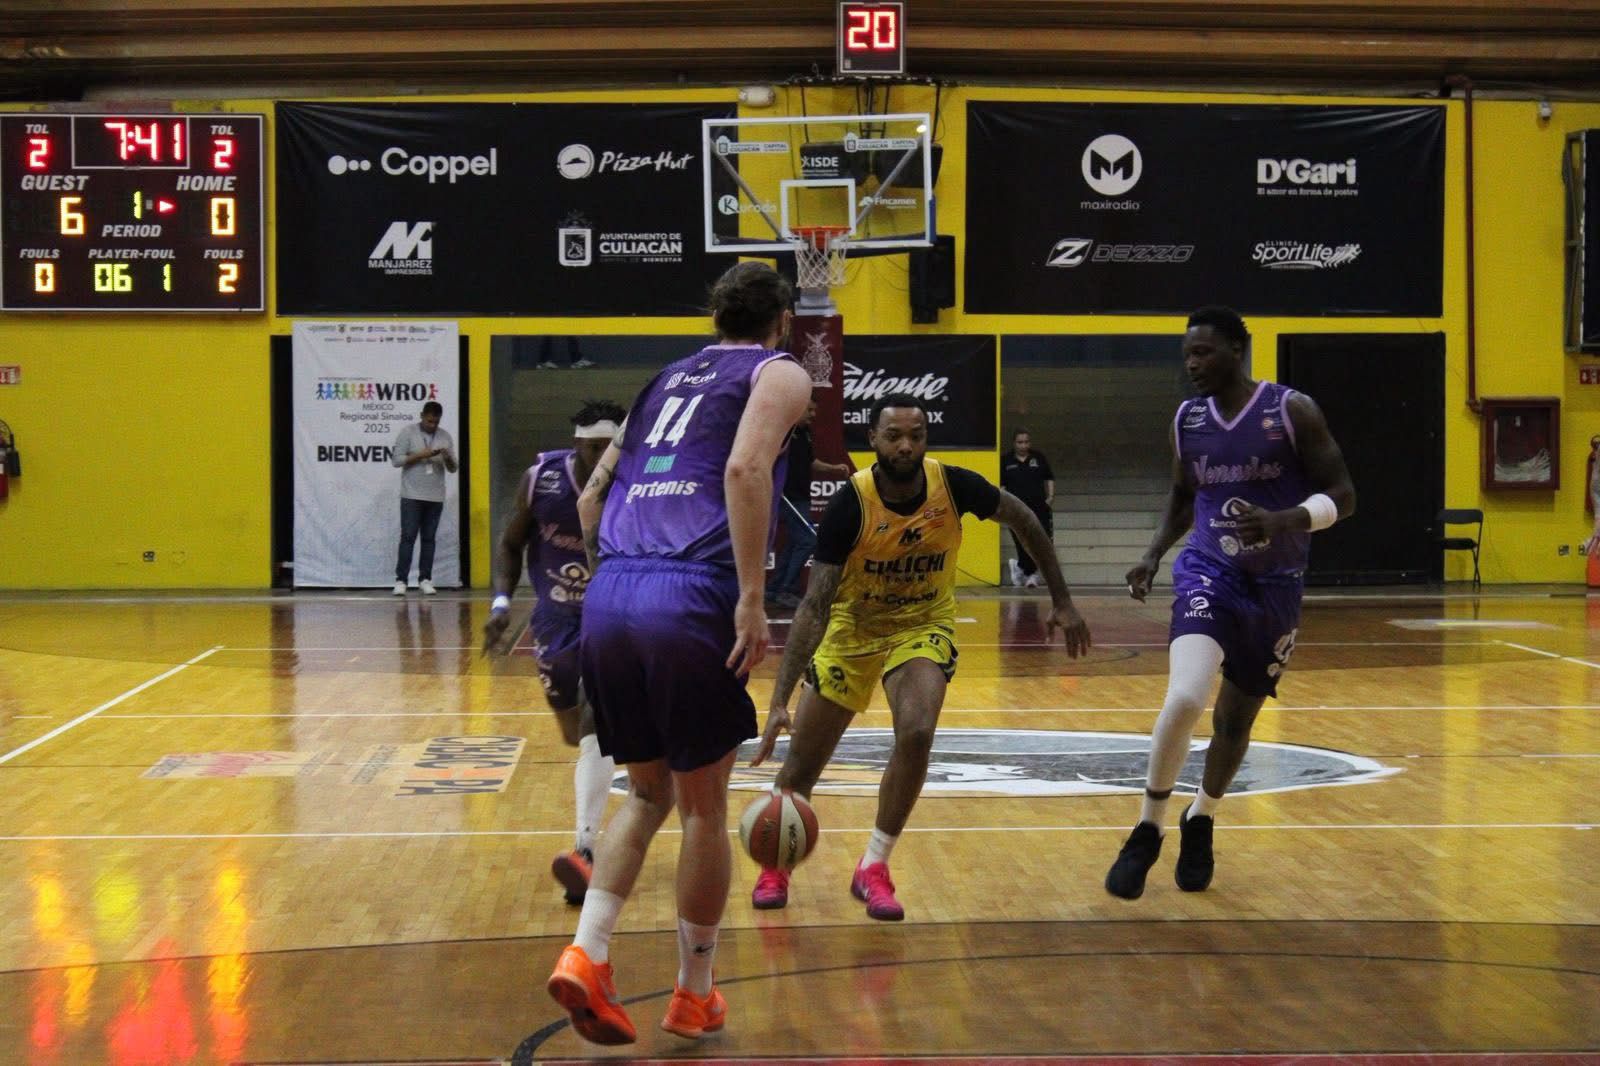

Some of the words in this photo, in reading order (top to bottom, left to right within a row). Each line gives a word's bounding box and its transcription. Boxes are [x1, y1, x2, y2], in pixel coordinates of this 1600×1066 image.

[848, 11, 896, 49] 20
[25, 124, 49, 135] TOL
[211, 125, 234, 135] TOL
[104, 122, 182, 160] 7:41
[29, 139, 48, 167] 2
[214, 140, 232, 168] 2
[598, 151, 652, 173] Pizza
[654, 151, 694, 171] Hut
[381, 147, 497, 184] Coppel
[1257, 159, 1356, 184] D'Gari
[21, 175, 89, 190] GUEST
[176, 176, 237, 191] HOME
[133, 191, 142, 219] 1
[1080, 200, 1140, 210] maxiradio
[60, 197, 84, 234] 6
[211, 198, 235, 235] 0
[102, 225, 162, 237] PERIOD
[20, 249, 60, 259] FOULS
[88, 249, 176, 259] PLAYER-FOUL
[204, 249, 244, 259] FOULS
[1092, 245, 1194, 262] DEZZO
[368, 260, 432, 268] MANJARREZ
[34, 263, 54, 292] 0
[94, 263, 132, 292] 06
[163, 263, 171, 292] 1
[218, 263, 238, 293] 2
[376, 383, 426, 401] WRO
[340, 412, 379, 422] Regional
[381, 412, 413, 421] Sinaloa
[644, 394, 704, 448] 44
[364, 423, 391, 434] 2025
[317, 445, 395, 462] BIENVEN
[1184, 610, 1214, 619] MEGA
